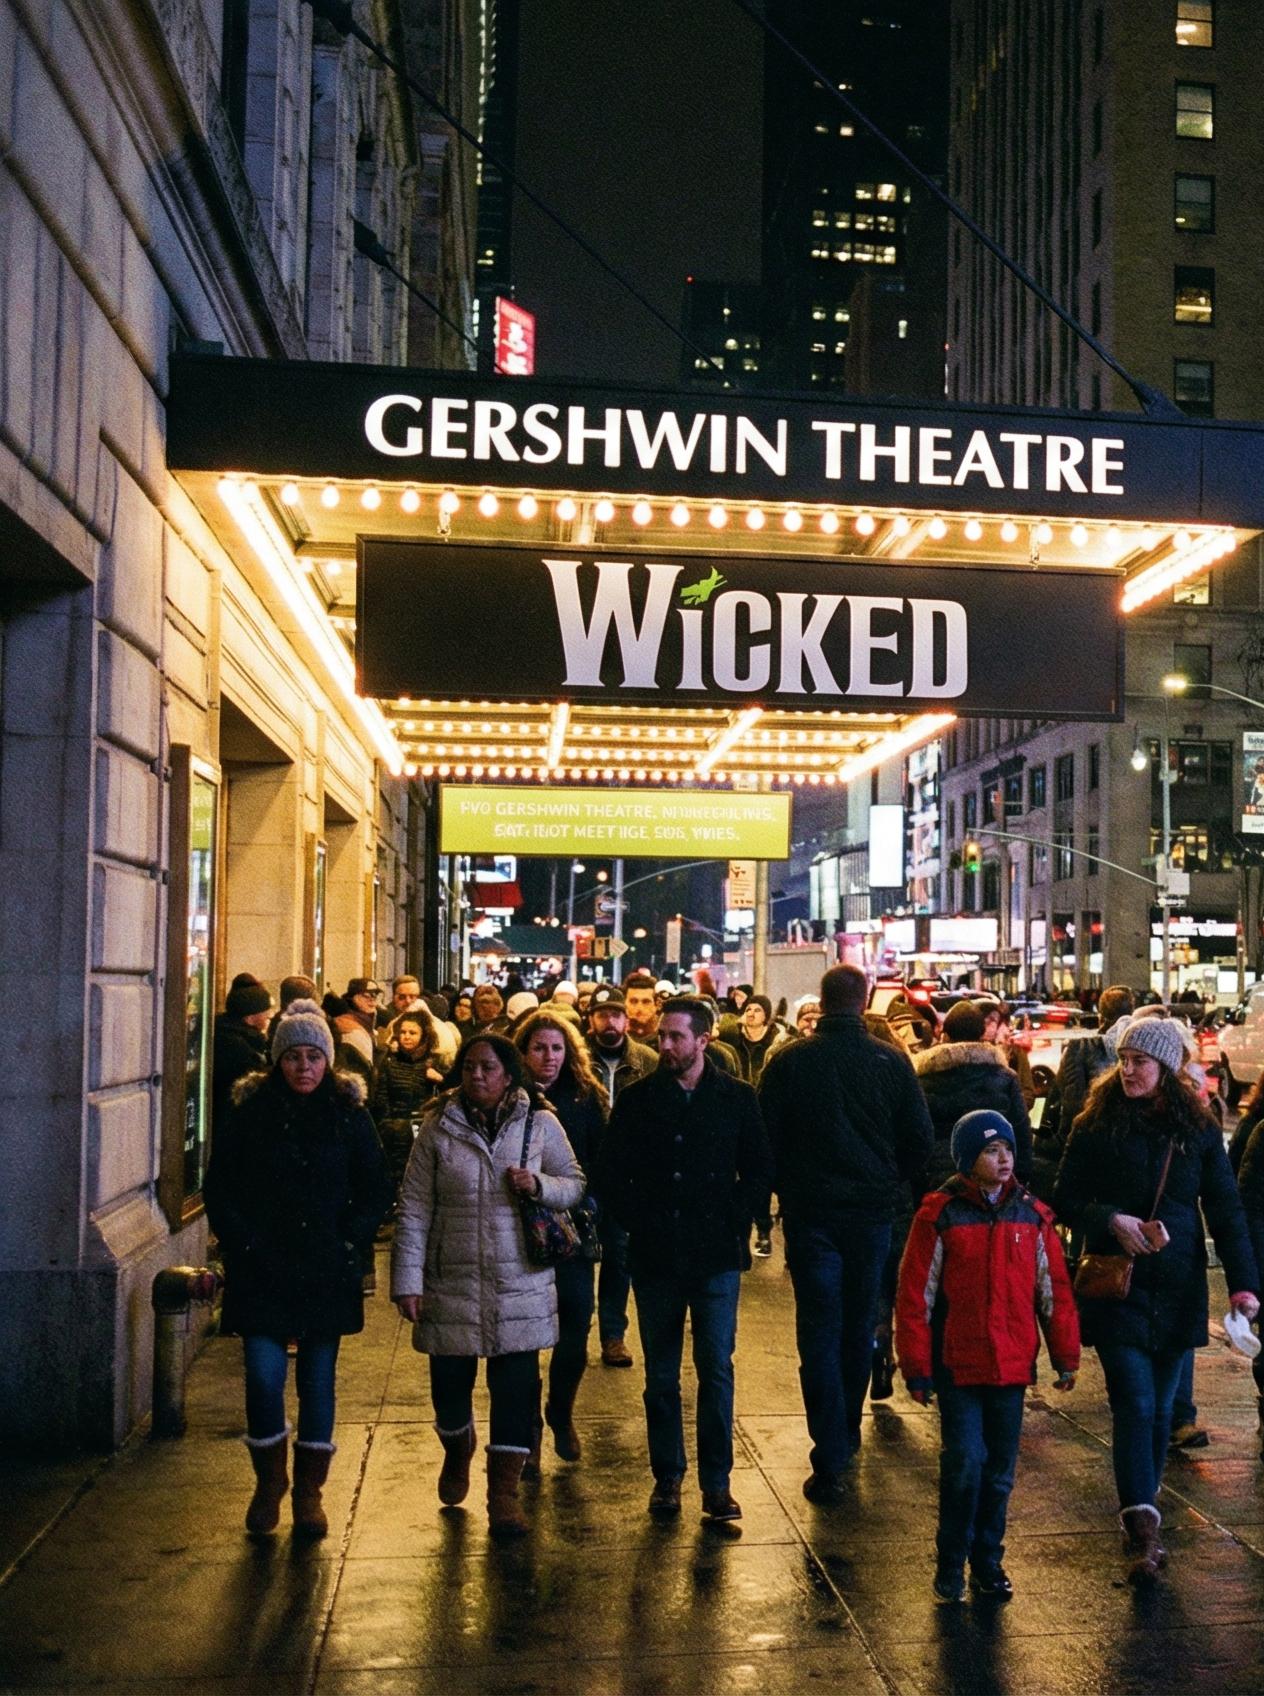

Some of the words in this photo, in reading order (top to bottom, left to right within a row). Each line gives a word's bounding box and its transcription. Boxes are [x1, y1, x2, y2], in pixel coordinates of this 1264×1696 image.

[364, 394, 787, 476] GERSHWIN
[812, 420, 1125, 495] THEATRE
[495, 802, 580, 817] GERSHWIN
